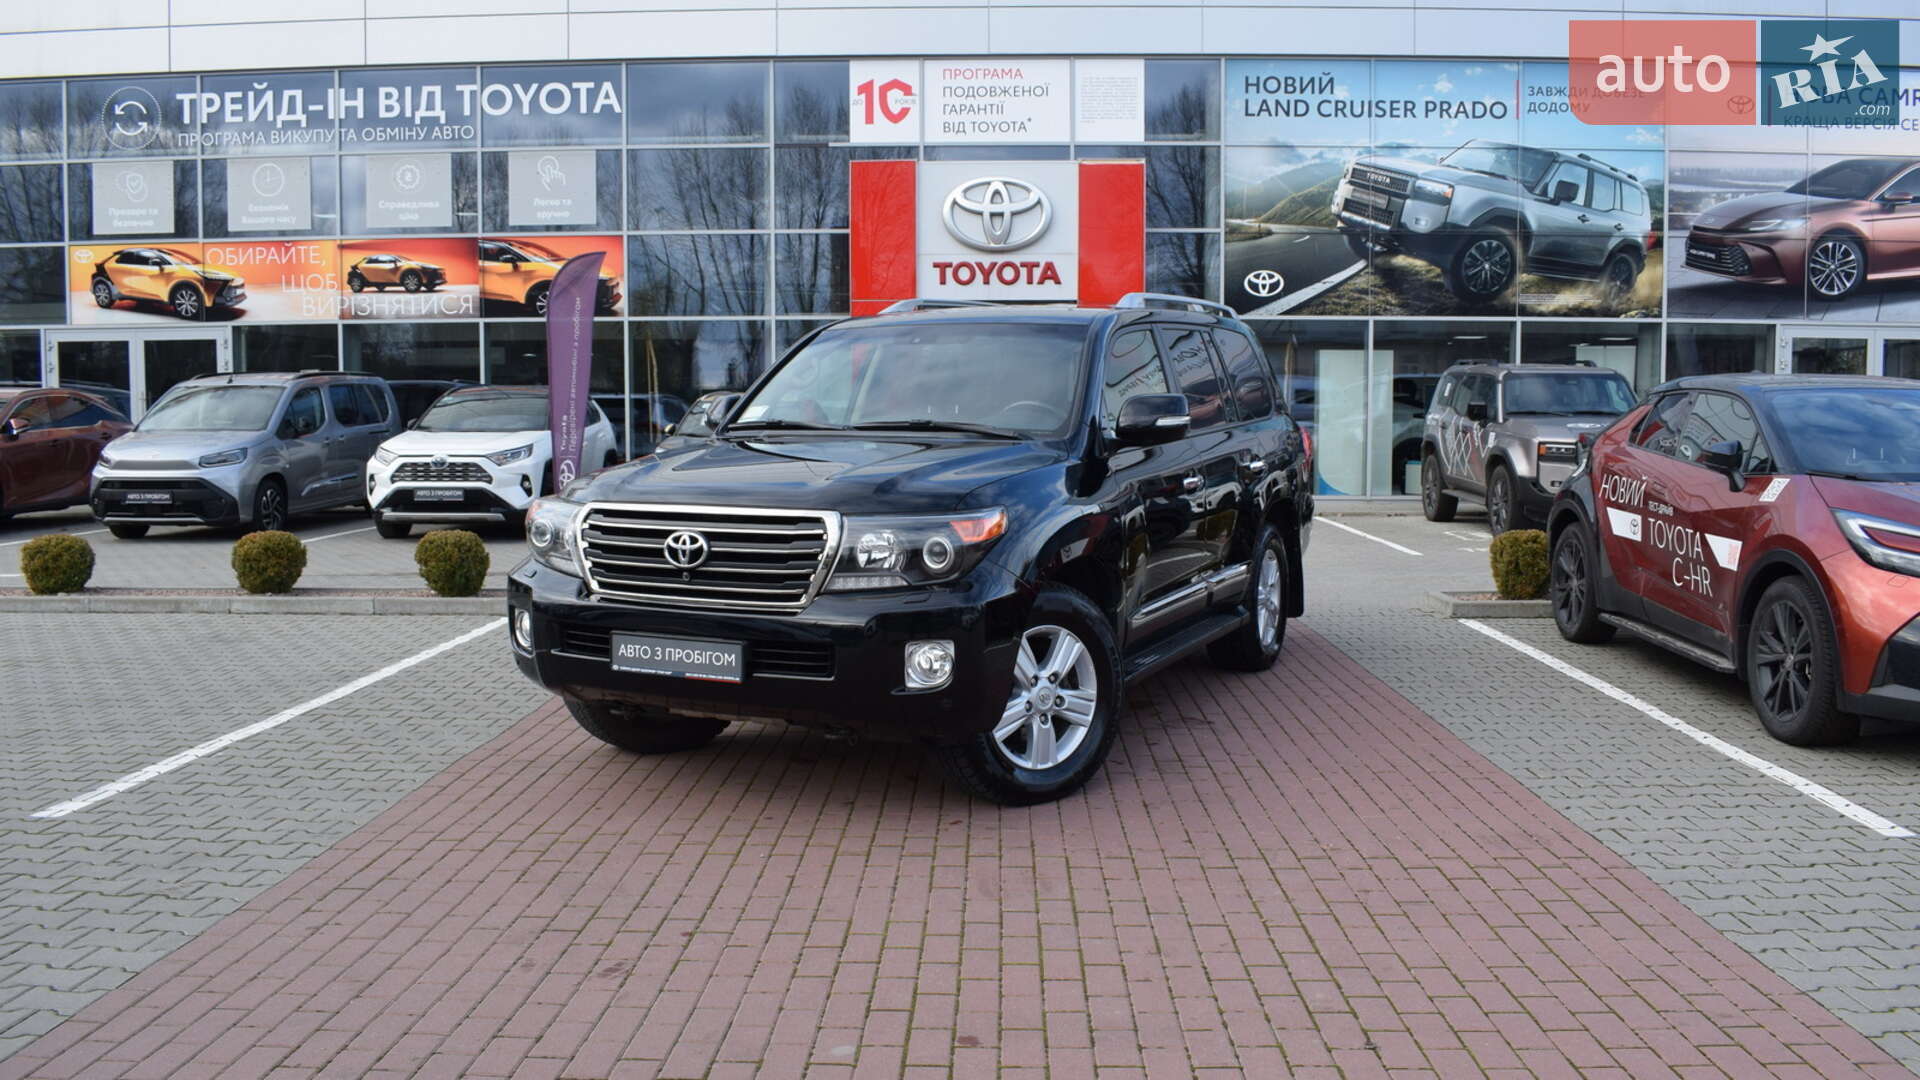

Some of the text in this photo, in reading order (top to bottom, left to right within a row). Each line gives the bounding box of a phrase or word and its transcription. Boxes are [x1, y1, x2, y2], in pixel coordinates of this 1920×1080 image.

[942, 68, 1024, 80] ПРОГРАМА
[1244, 72, 1335, 95] НОВИЙ
[942, 82, 1050, 99] ПОДОВЖЕНОЇ
[176, 81, 622, 128] ТРЕЙД-ІН ВІД TOYOTA
[942, 101, 1005, 115] ГАРАНТІЇ
[1244, 98, 1508, 120] LAND CRUISER PRADO
[1528, 101, 1591, 113] ДОДОМУ
[178, 125, 475, 147] ПРОГРАМА ВИКУПУ ТА ОБМІНУ АВТО
[943, 121, 967, 135] ВІД
[206, 243, 326, 267] ОБИРАЙТЕ,
[932, 261, 1062, 286] TOYOTA
[302, 294, 474, 317] ВИРІЗНЯТИСЯ
[1599, 474, 1648, 508] НОВИЙ
[1648, 517, 1705, 561] TOYOTA
[1672, 557, 1713, 597] C-HR
[618, 644, 736, 667] АВТО З ПРОБІГОМ
